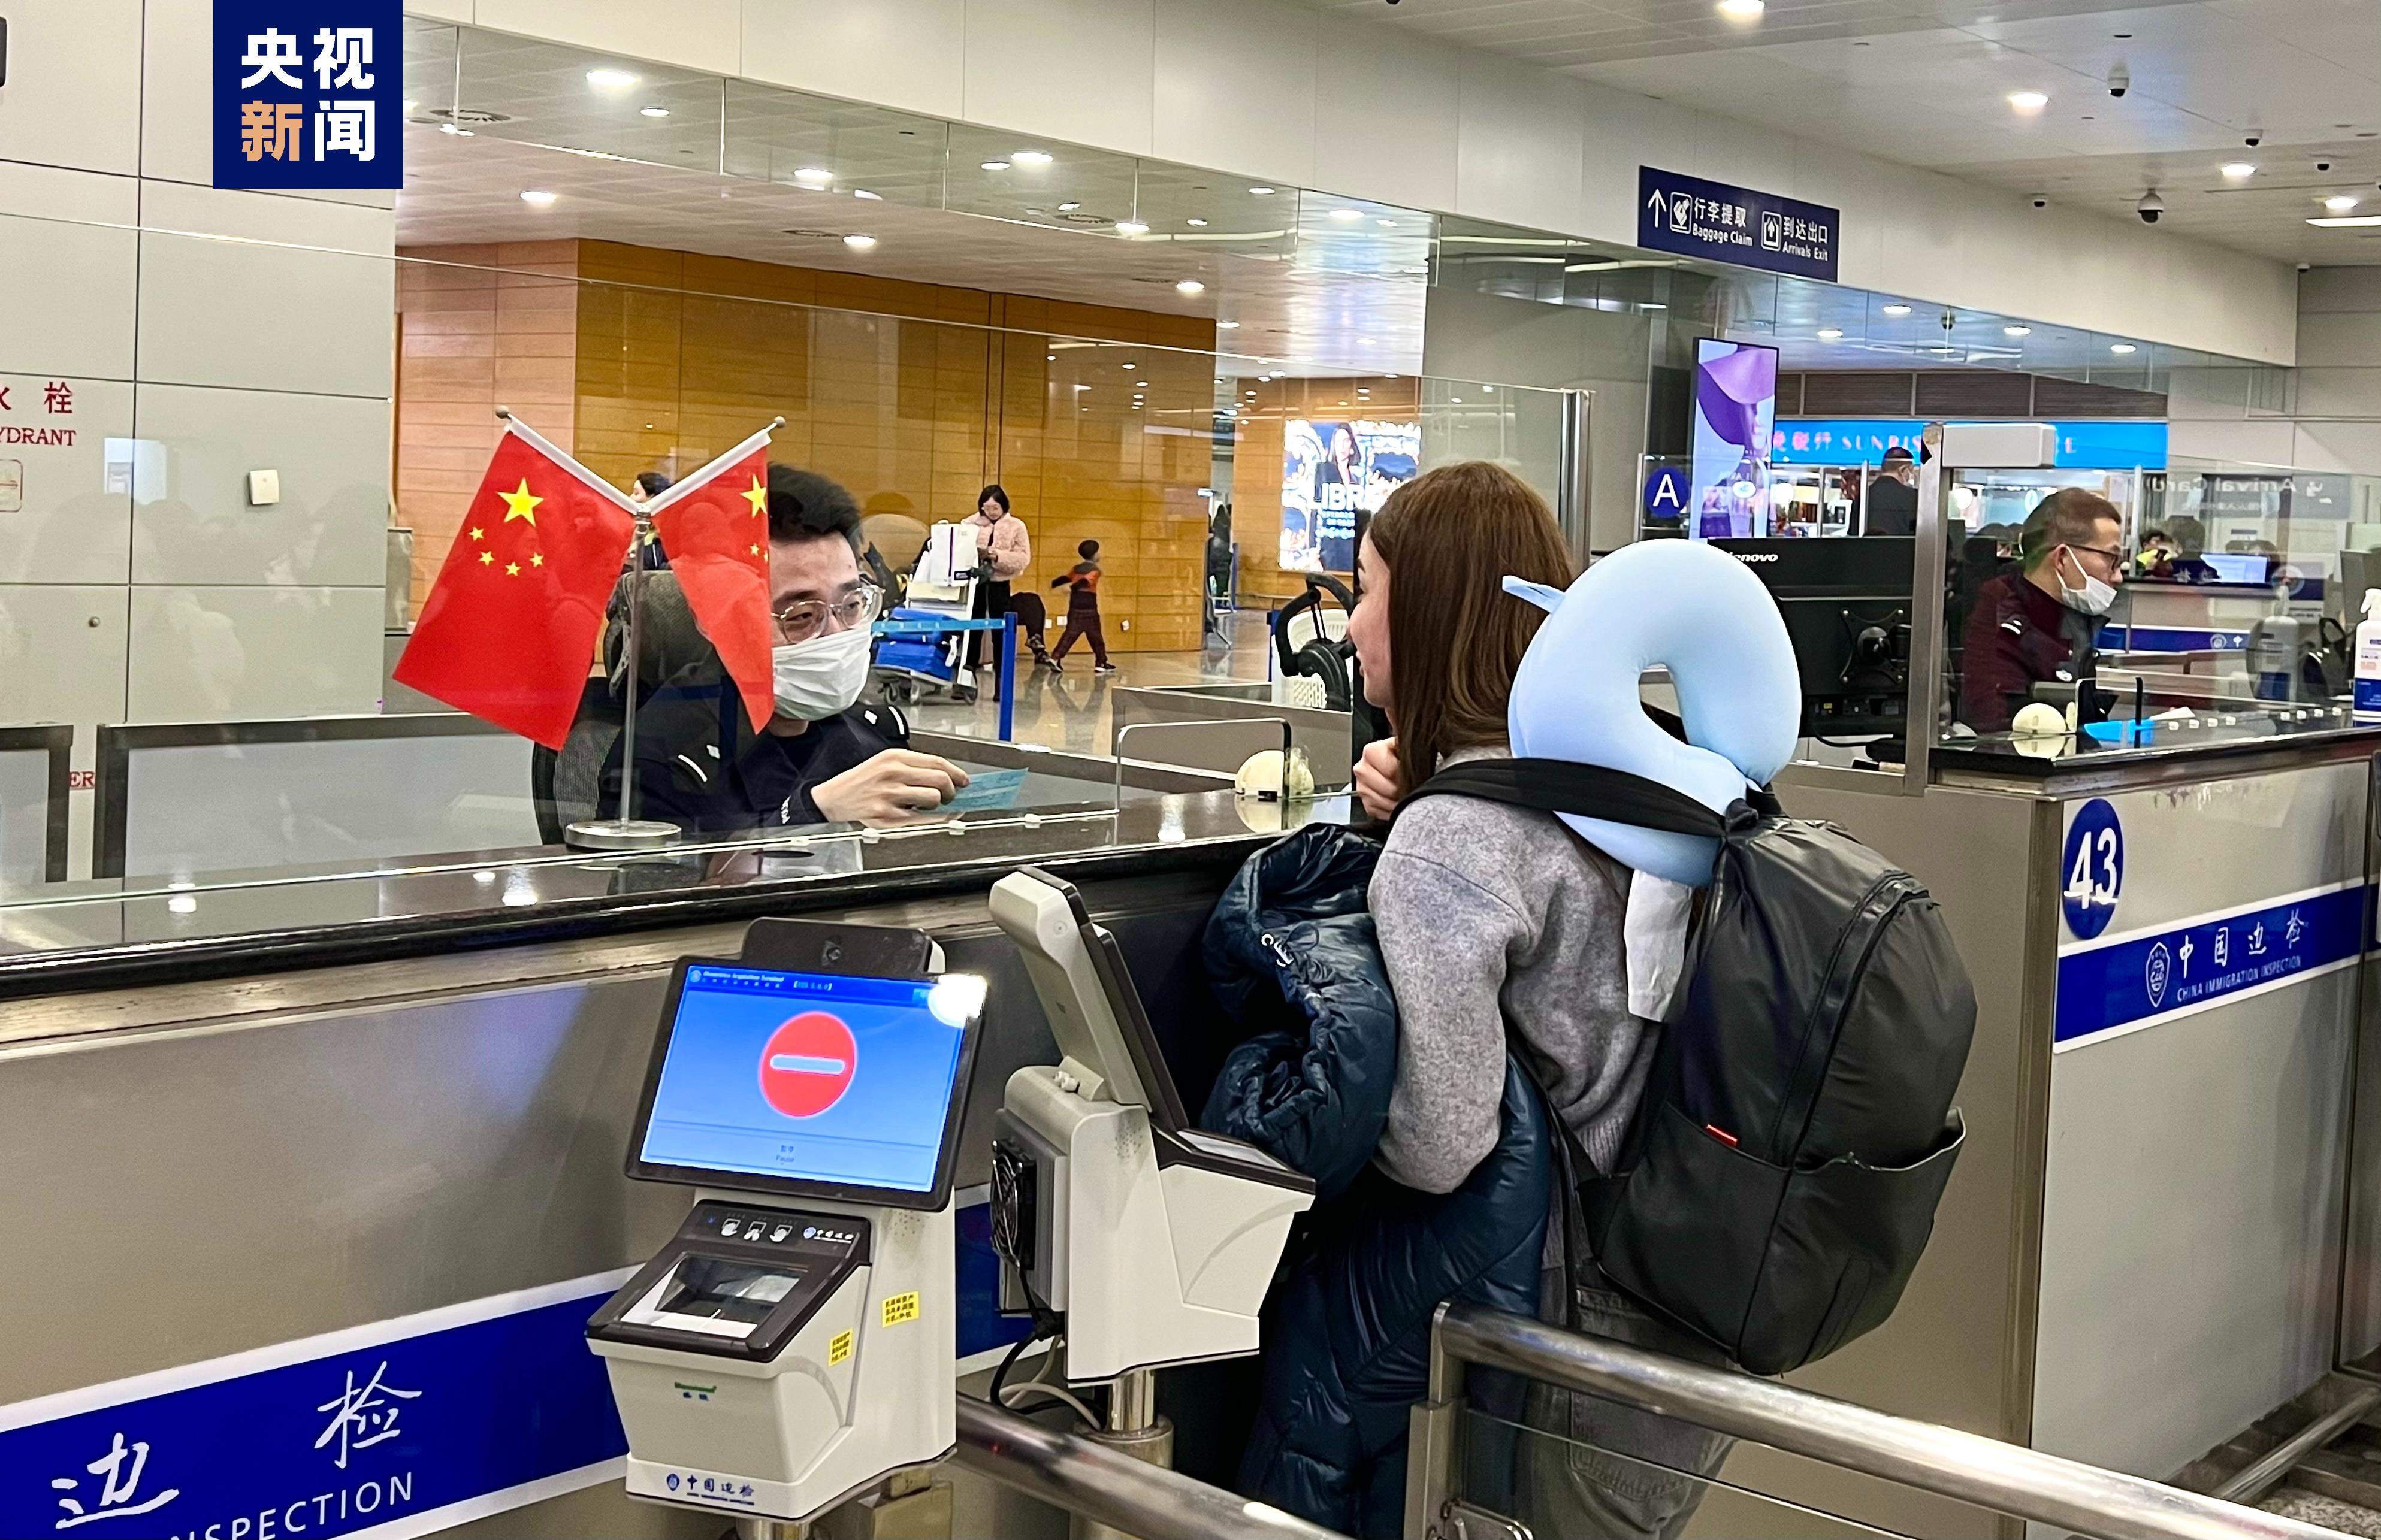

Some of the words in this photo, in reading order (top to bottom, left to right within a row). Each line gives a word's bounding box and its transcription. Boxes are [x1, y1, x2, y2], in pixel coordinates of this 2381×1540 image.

[1694, 196, 1747, 228] 行李提取
[1693, 223, 1729, 244] Baggage
[1730, 230, 1753, 247] Claim
[1783, 216, 1827, 244] 到达出口
[1782, 241, 1811, 258] Arrivals
[1814, 247, 1828, 261] Exit
[1652, 473, 1680, 508] A
[2069, 827, 2118, 910] 43
[2179, 908, 2309, 979] 中国边检
[2177, 982, 2203, 1002] CHINA
[2205, 968, 2259, 994] IMMIGRATION
[2261, 955, 2302, 978] INSPECTION
[170, 1471, 412, 1540] SPECTION
